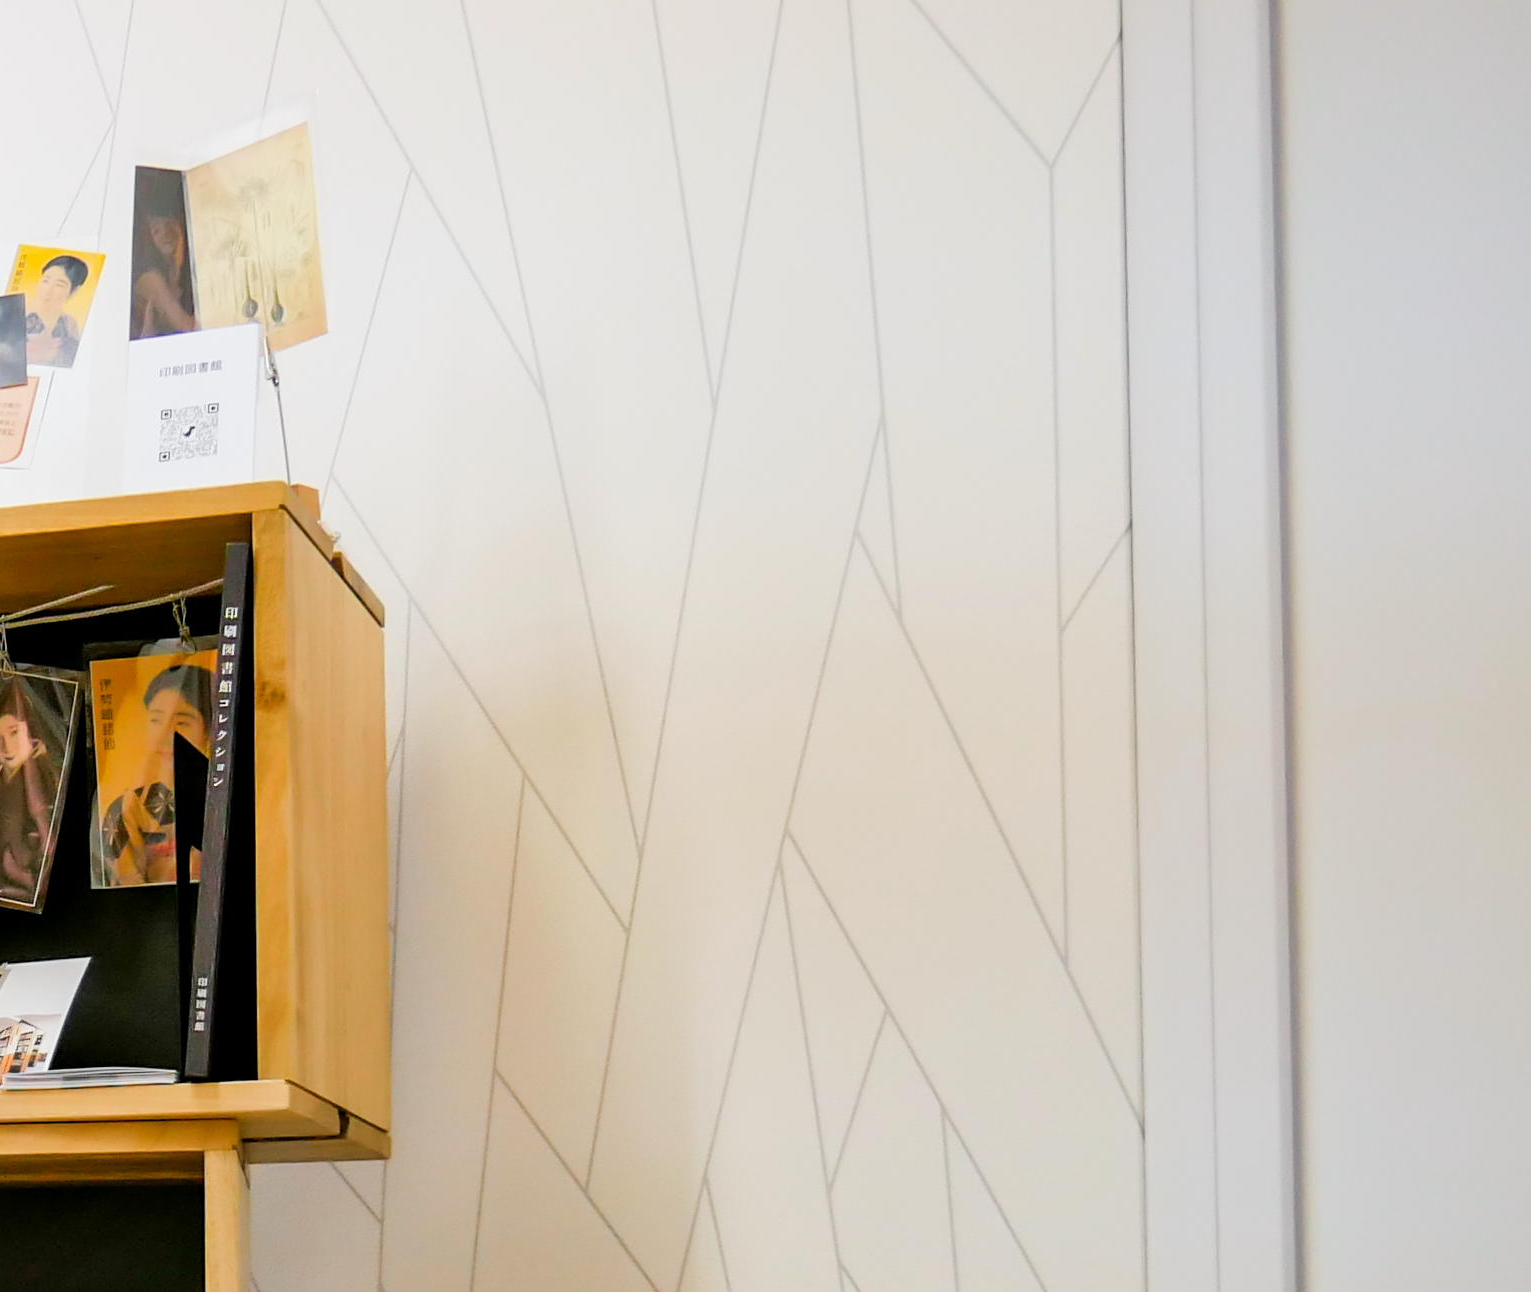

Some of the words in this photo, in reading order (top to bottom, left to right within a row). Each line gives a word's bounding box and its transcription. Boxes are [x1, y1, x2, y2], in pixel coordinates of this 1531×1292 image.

[159, 360, 223, 378] 印刷図書館
